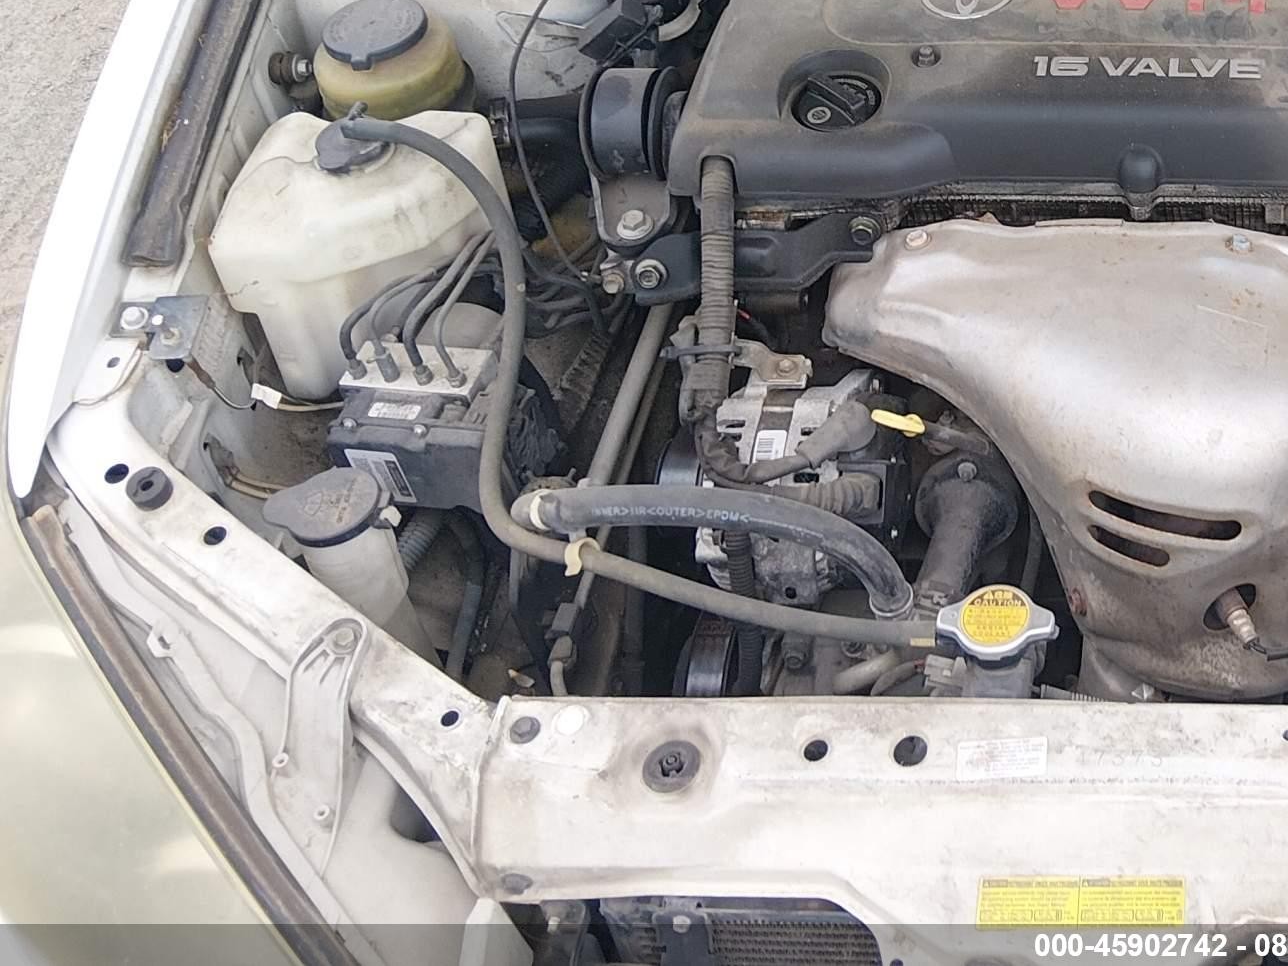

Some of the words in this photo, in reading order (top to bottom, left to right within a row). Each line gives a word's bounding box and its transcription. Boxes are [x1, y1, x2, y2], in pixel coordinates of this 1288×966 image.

[1033, 56, 1089, 77] 16
[1099, 56, 1264, 80] VALVE
[974, 598, 1021, 607] CAUTION
